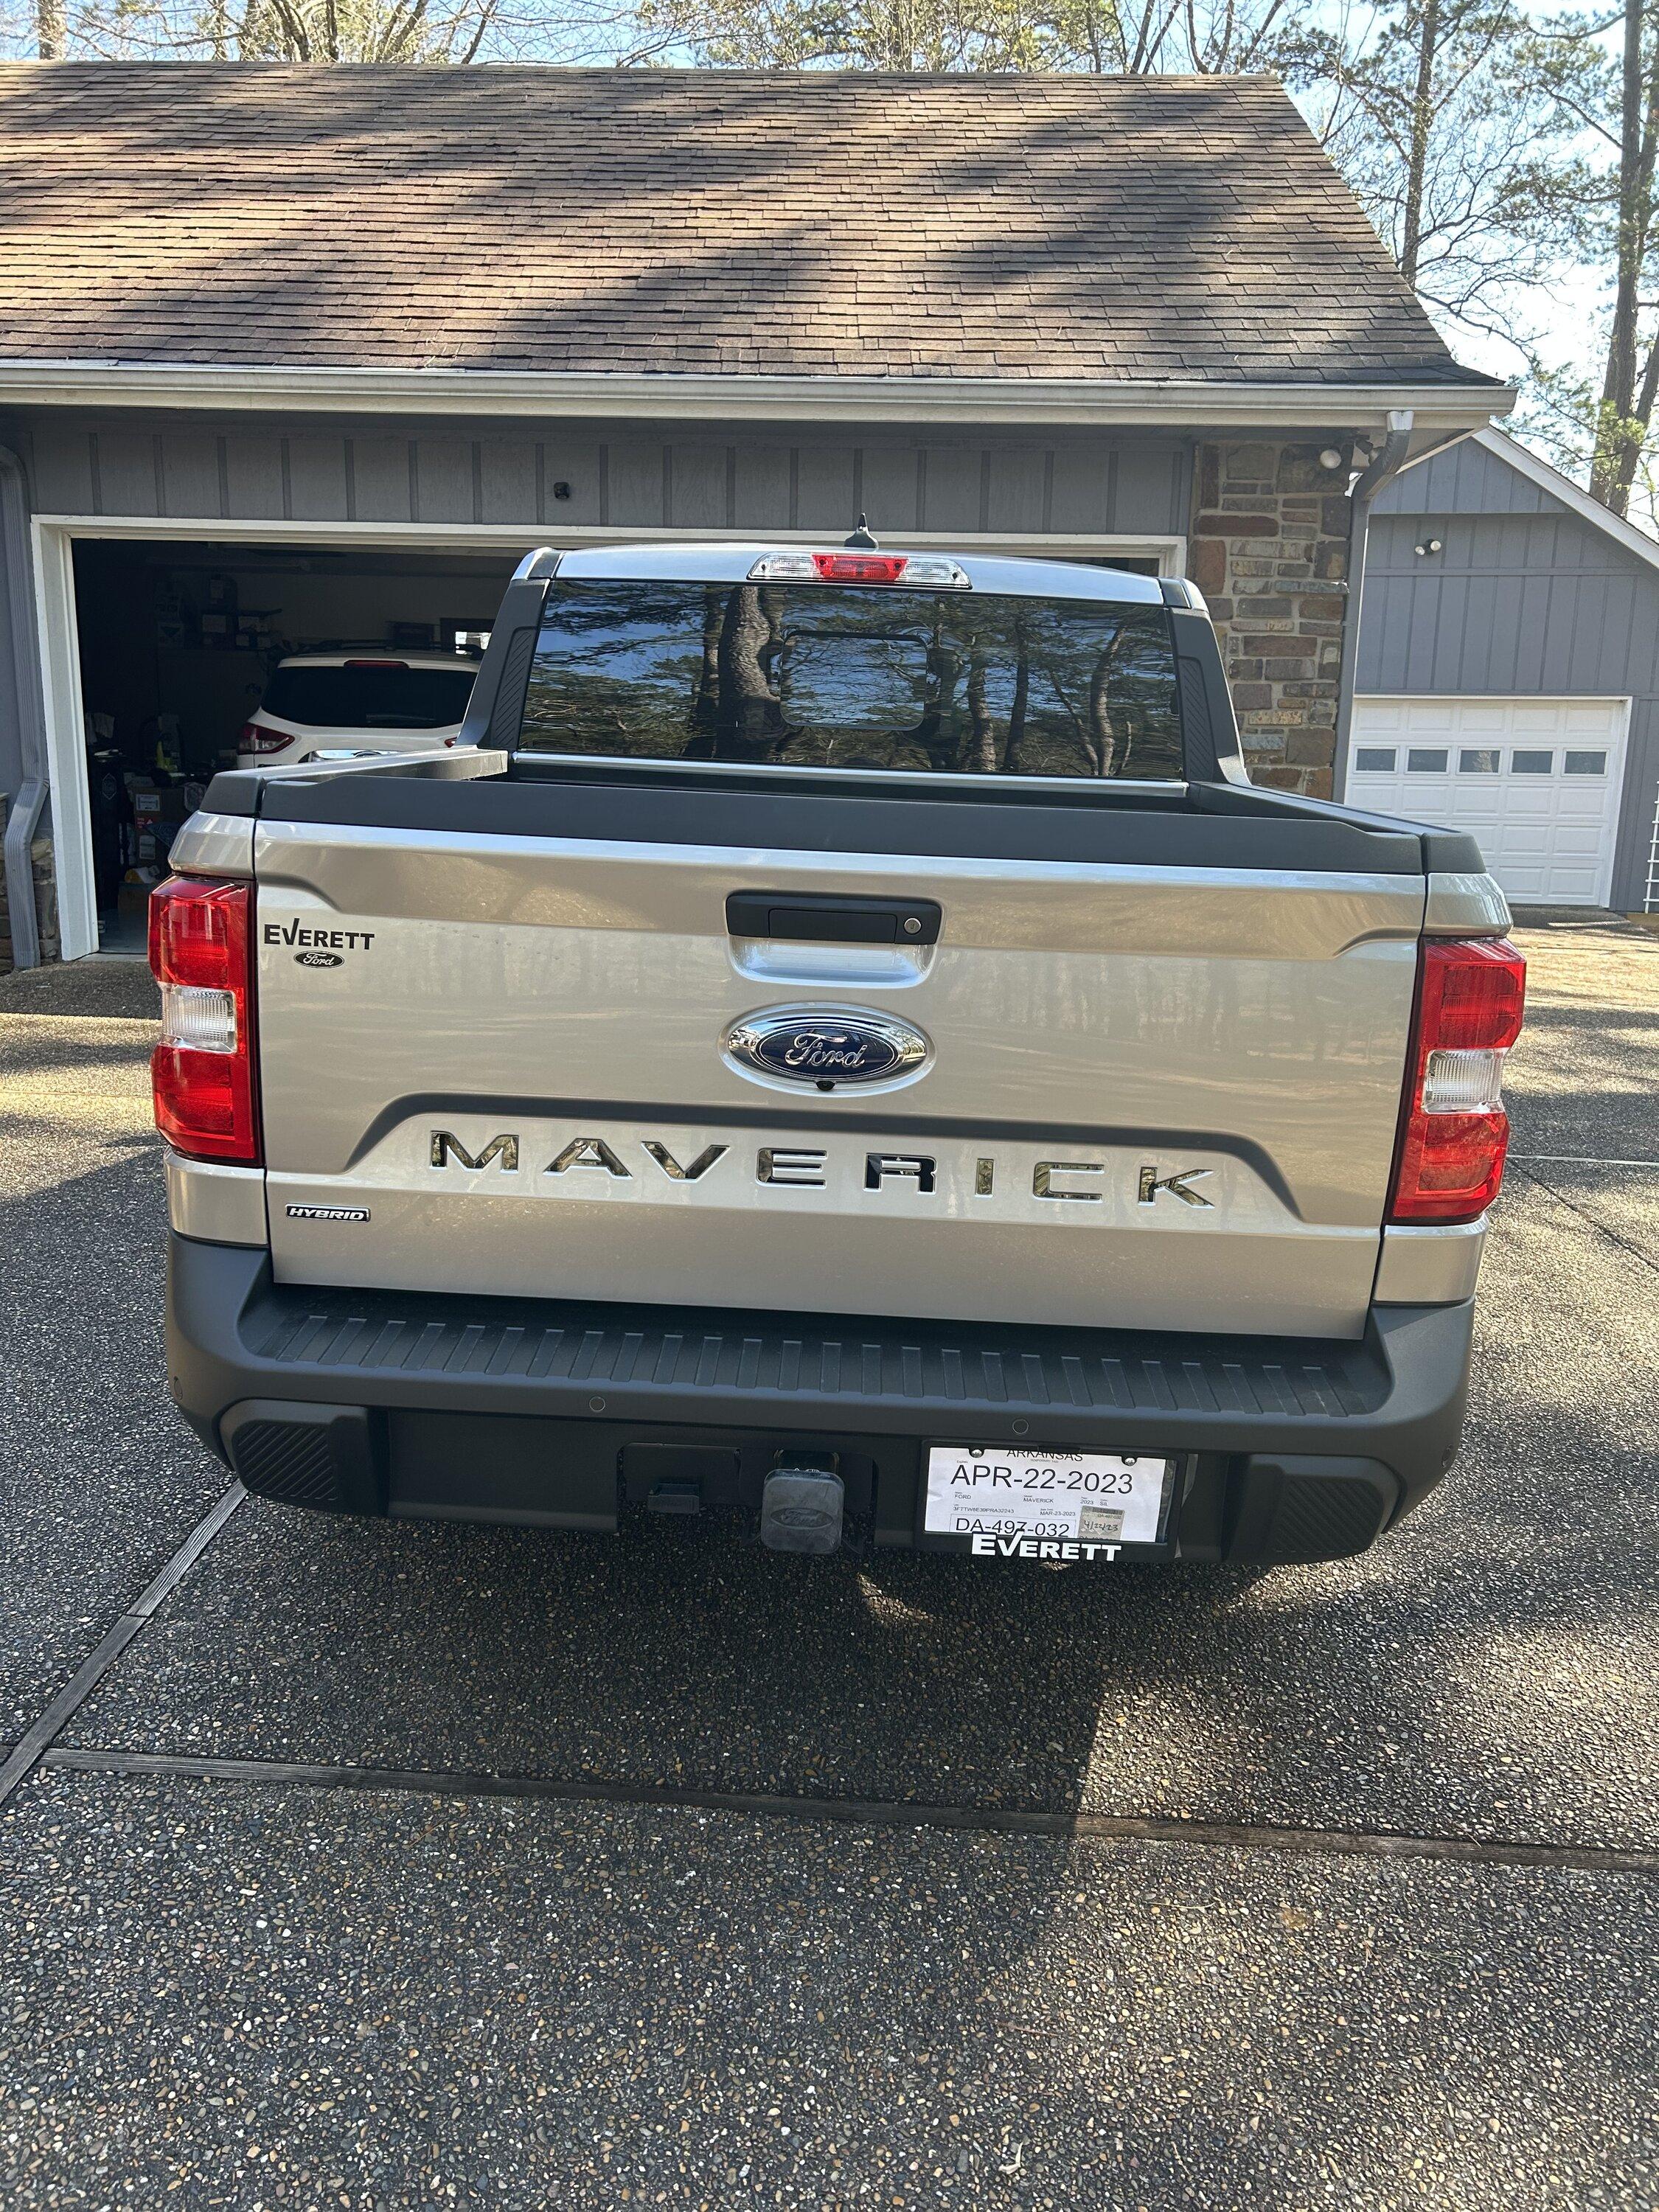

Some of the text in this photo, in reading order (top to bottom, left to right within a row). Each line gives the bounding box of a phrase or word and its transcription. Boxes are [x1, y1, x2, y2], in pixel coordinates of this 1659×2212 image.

[303, 953, 334, 966] Ford
[784, 1032, 869, 1068] Ford
[429, 1130, 1215, 1209] MAVERICK
[289, 1208, 365, 1221] HYBRID
[1006, 1449, 1084, 1462] ARKANSAS
[950, 1464, 1133, 1495] APR-22-2023
[956, 1517, 1070, 1538] DA-497-032
[1083, 1520, 1119, 1531] 4/22/23
